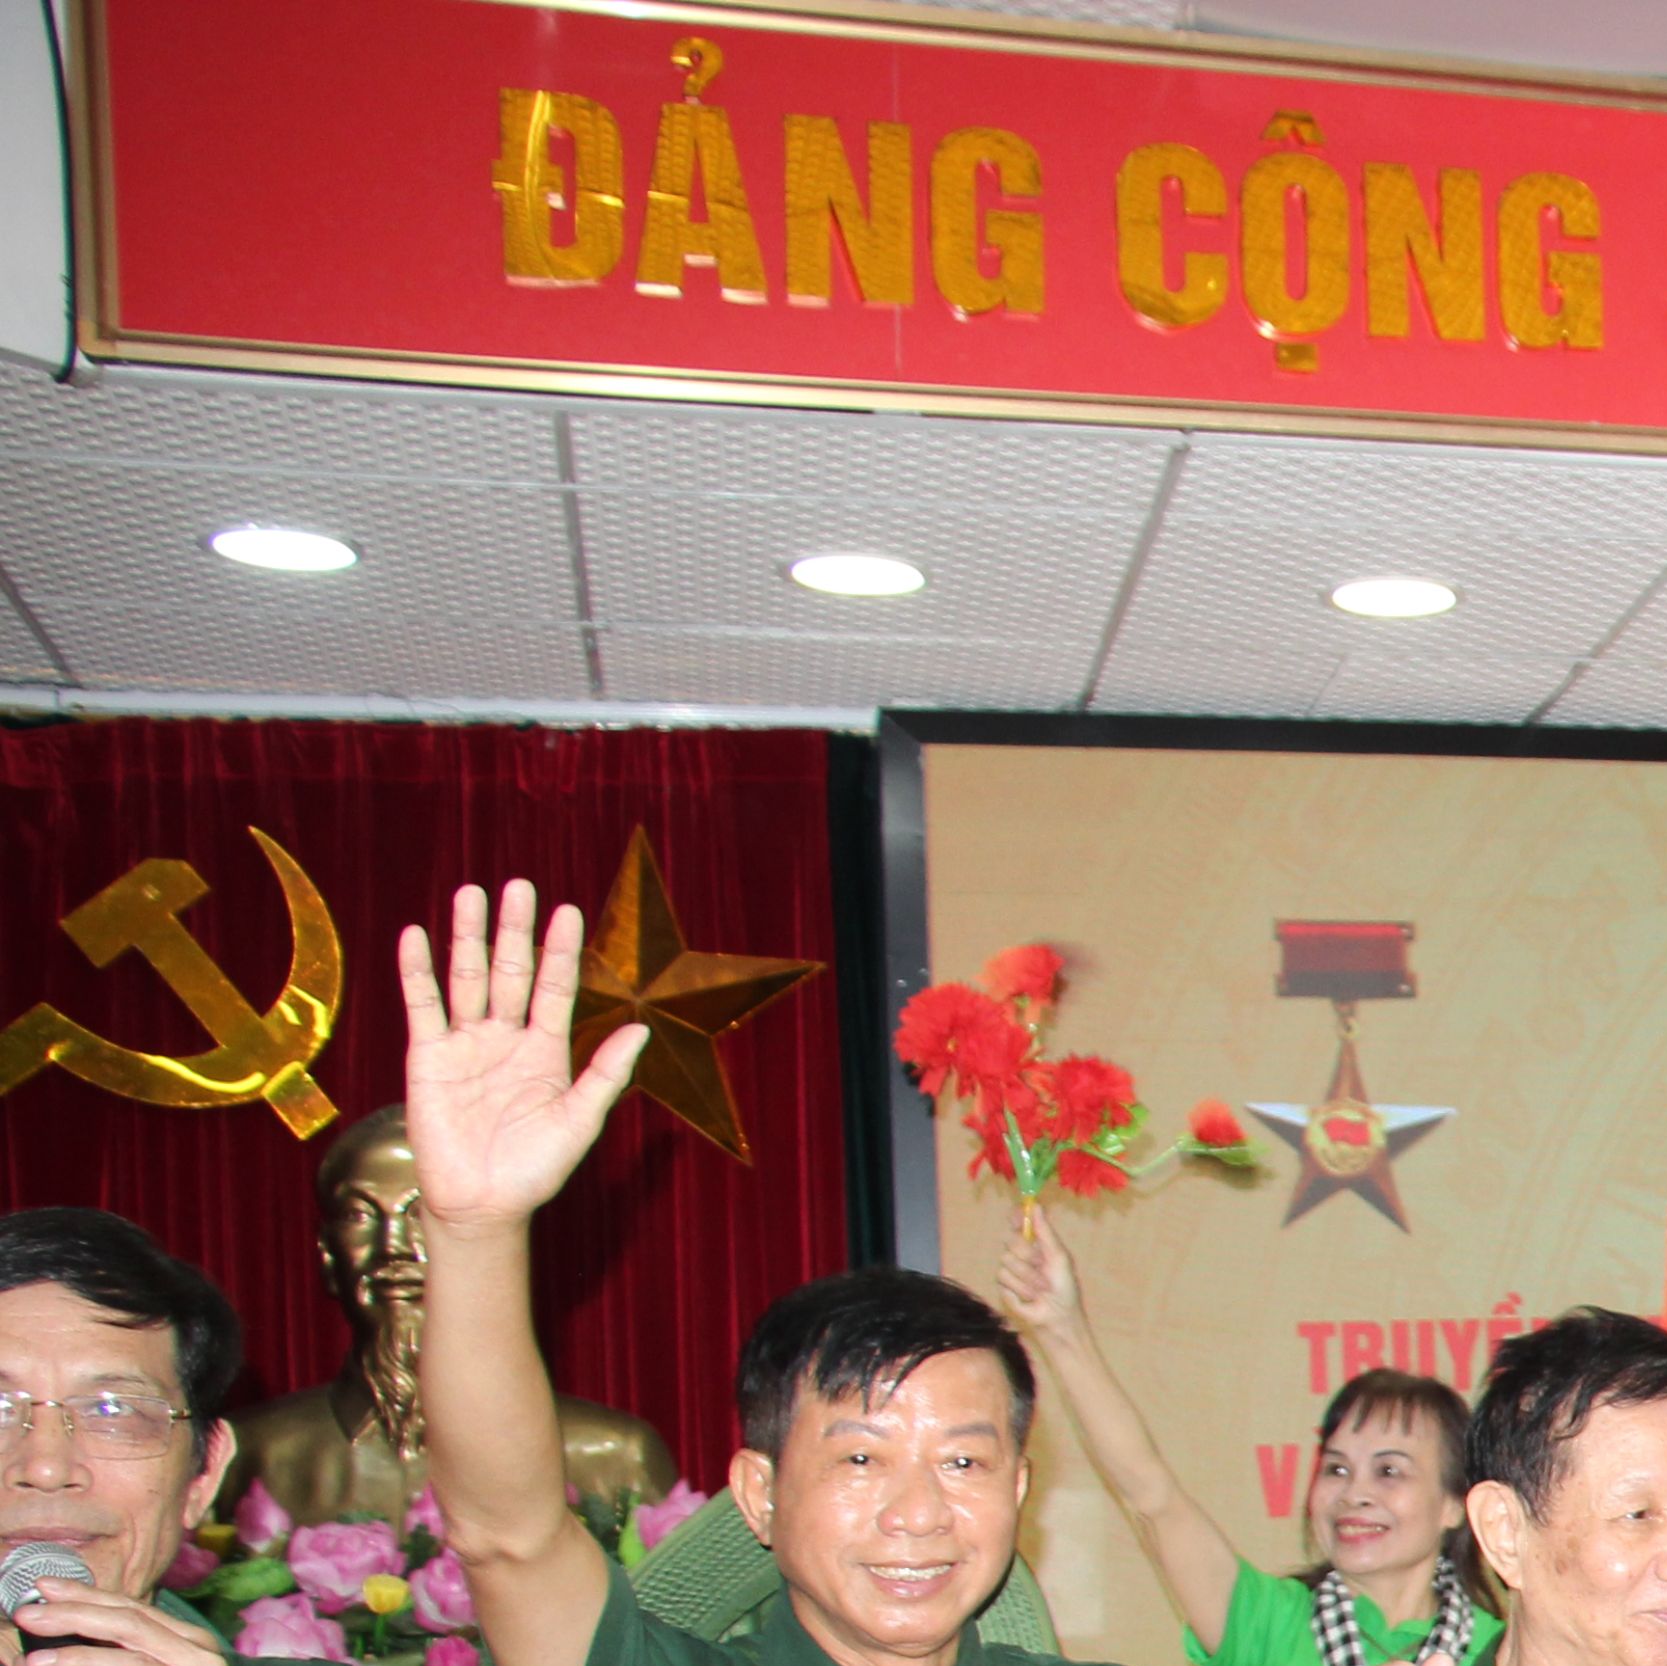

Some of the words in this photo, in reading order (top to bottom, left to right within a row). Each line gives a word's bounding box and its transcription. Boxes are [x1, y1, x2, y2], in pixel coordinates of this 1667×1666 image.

[493, 37, 1045, 320] ĐẢNG
[1115, 109, 1604, 373] CỘNG
[1297, 1291, 1557, 1396] TRUY
